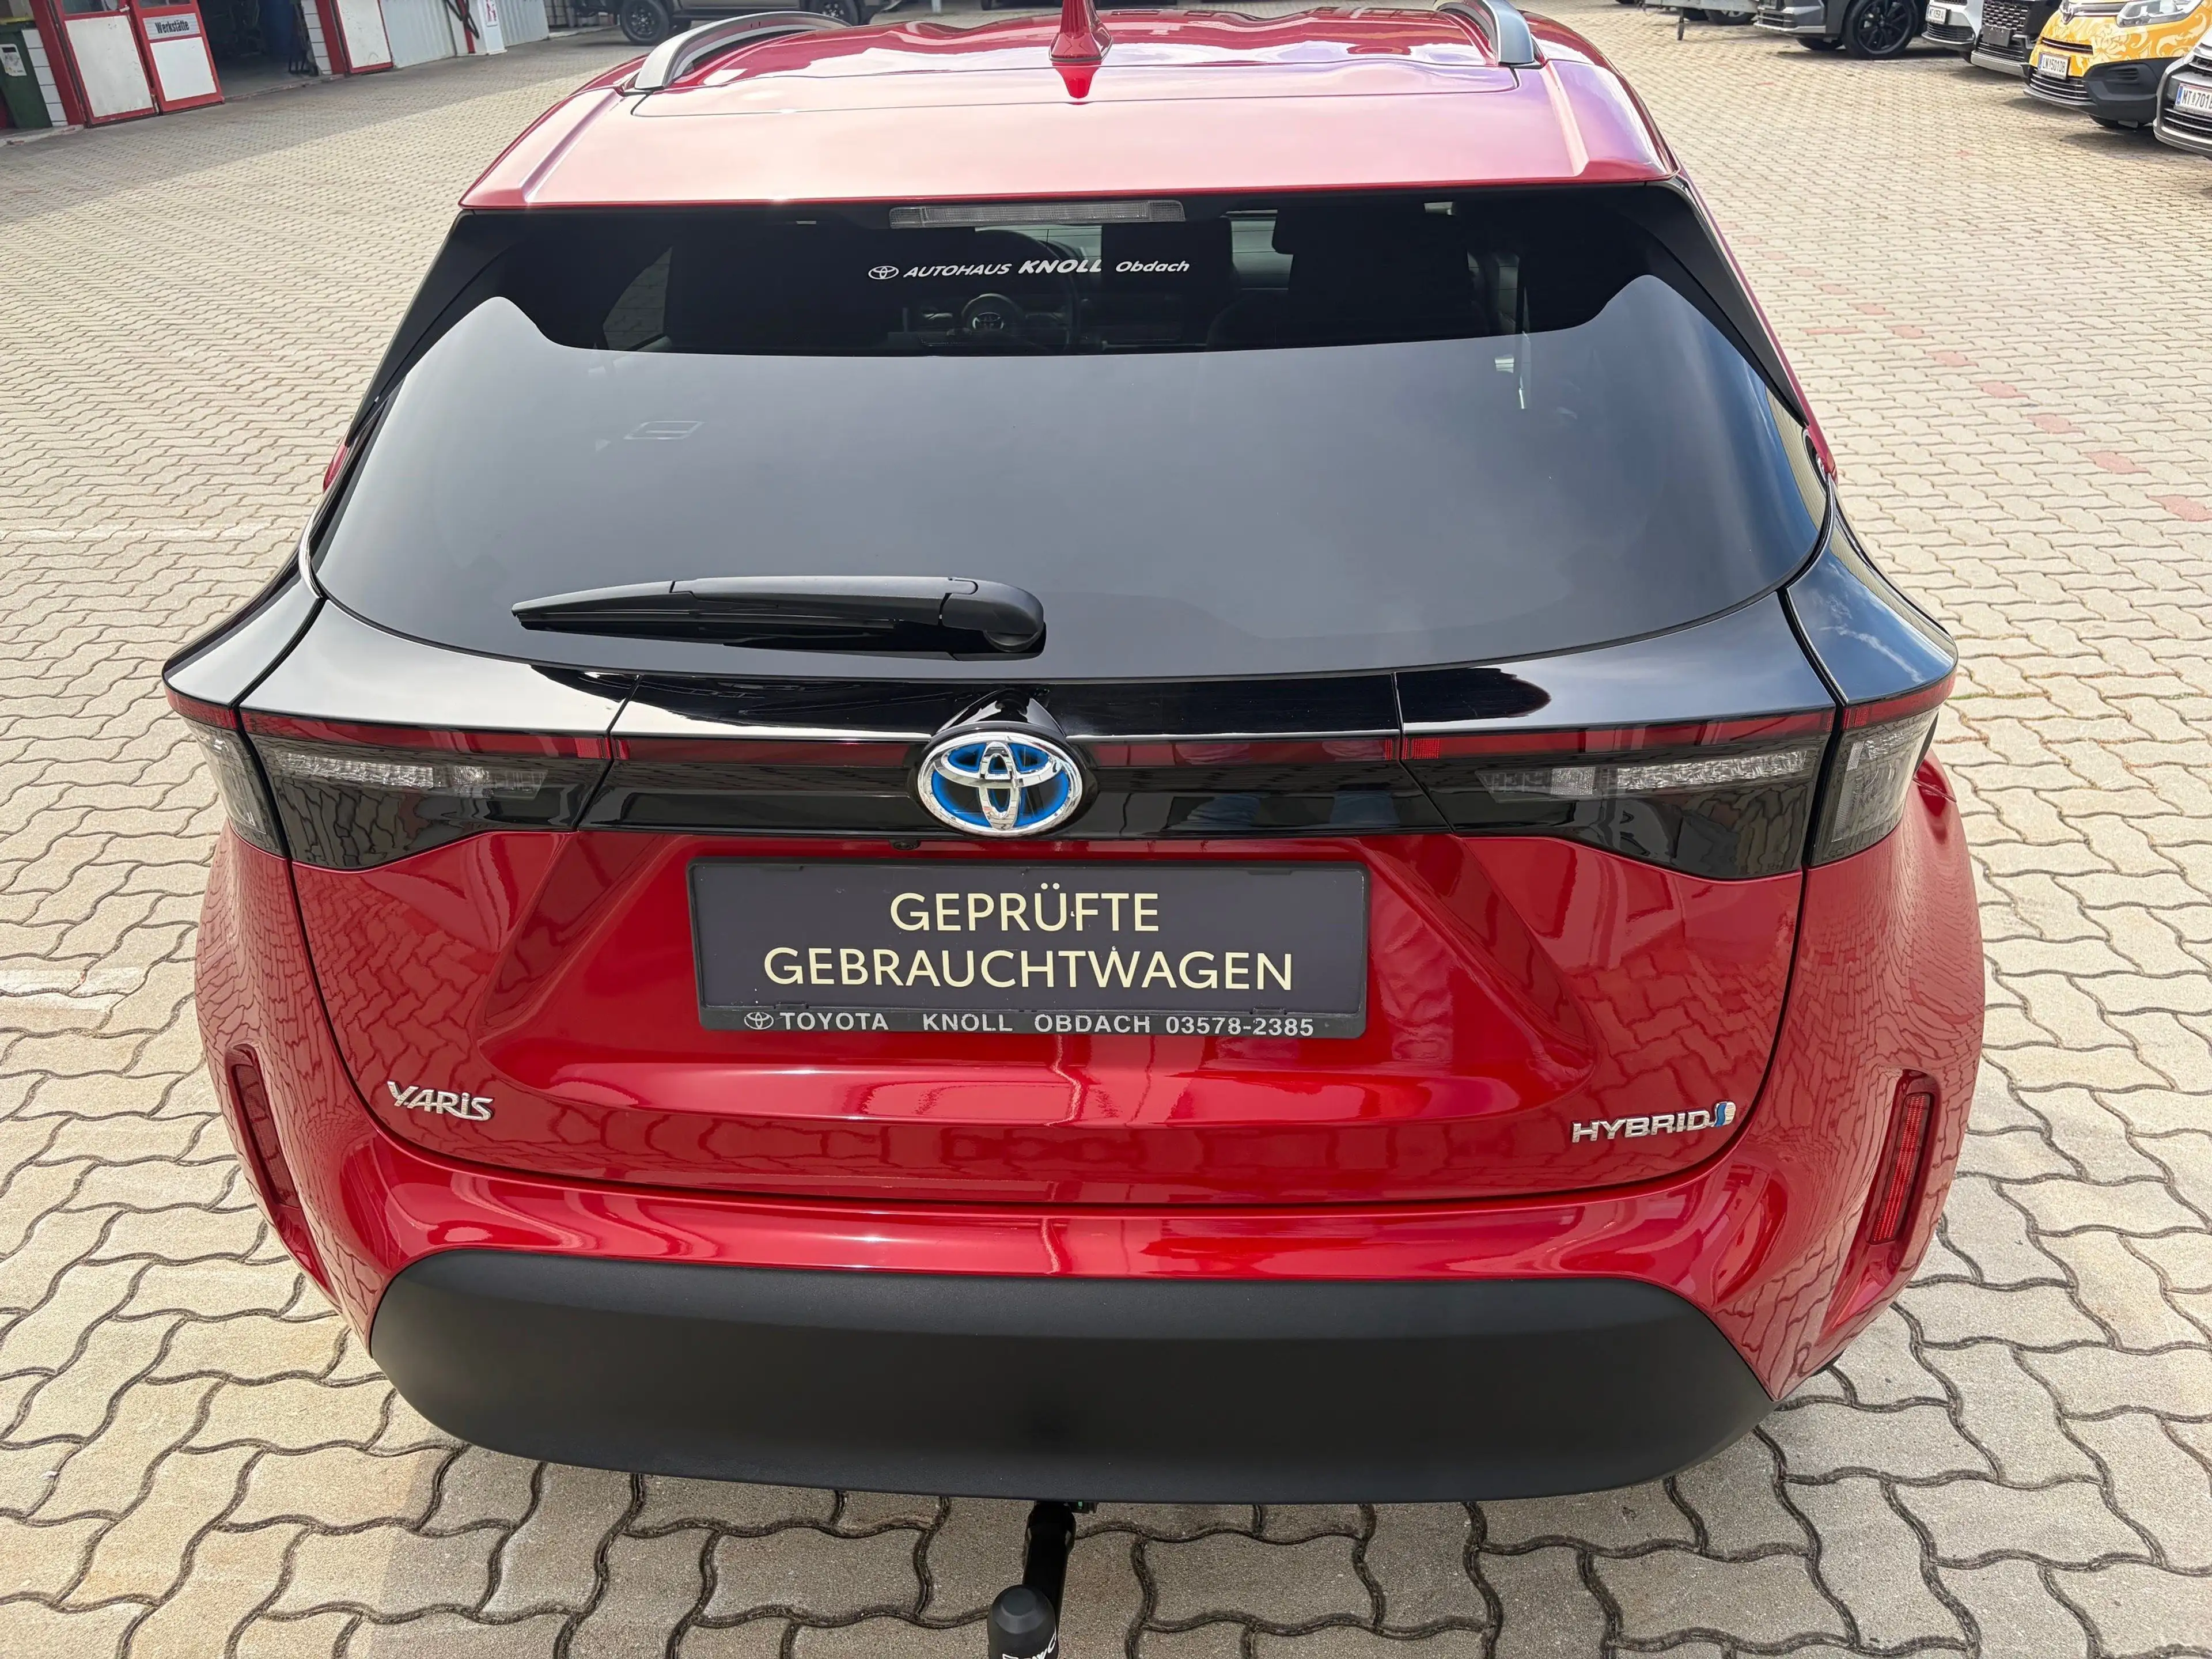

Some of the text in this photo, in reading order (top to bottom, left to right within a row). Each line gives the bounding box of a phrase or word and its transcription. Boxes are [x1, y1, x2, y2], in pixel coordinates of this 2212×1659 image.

[155, 20, 190, 33] Werkstätte
[903, 259, 1191, 278] AUTOHAUS KNOLL Obdach
[889, 882, 1160, 932] GEPRÜFTE
[763, 946, 1293, 991] GEBRAUCHTWAGEN
[780, 1012, 1314, 1037] TOYOTA KNOLL OBDACH 03578-2385
[1571, 1109, 1710, 1143] HYBRID
